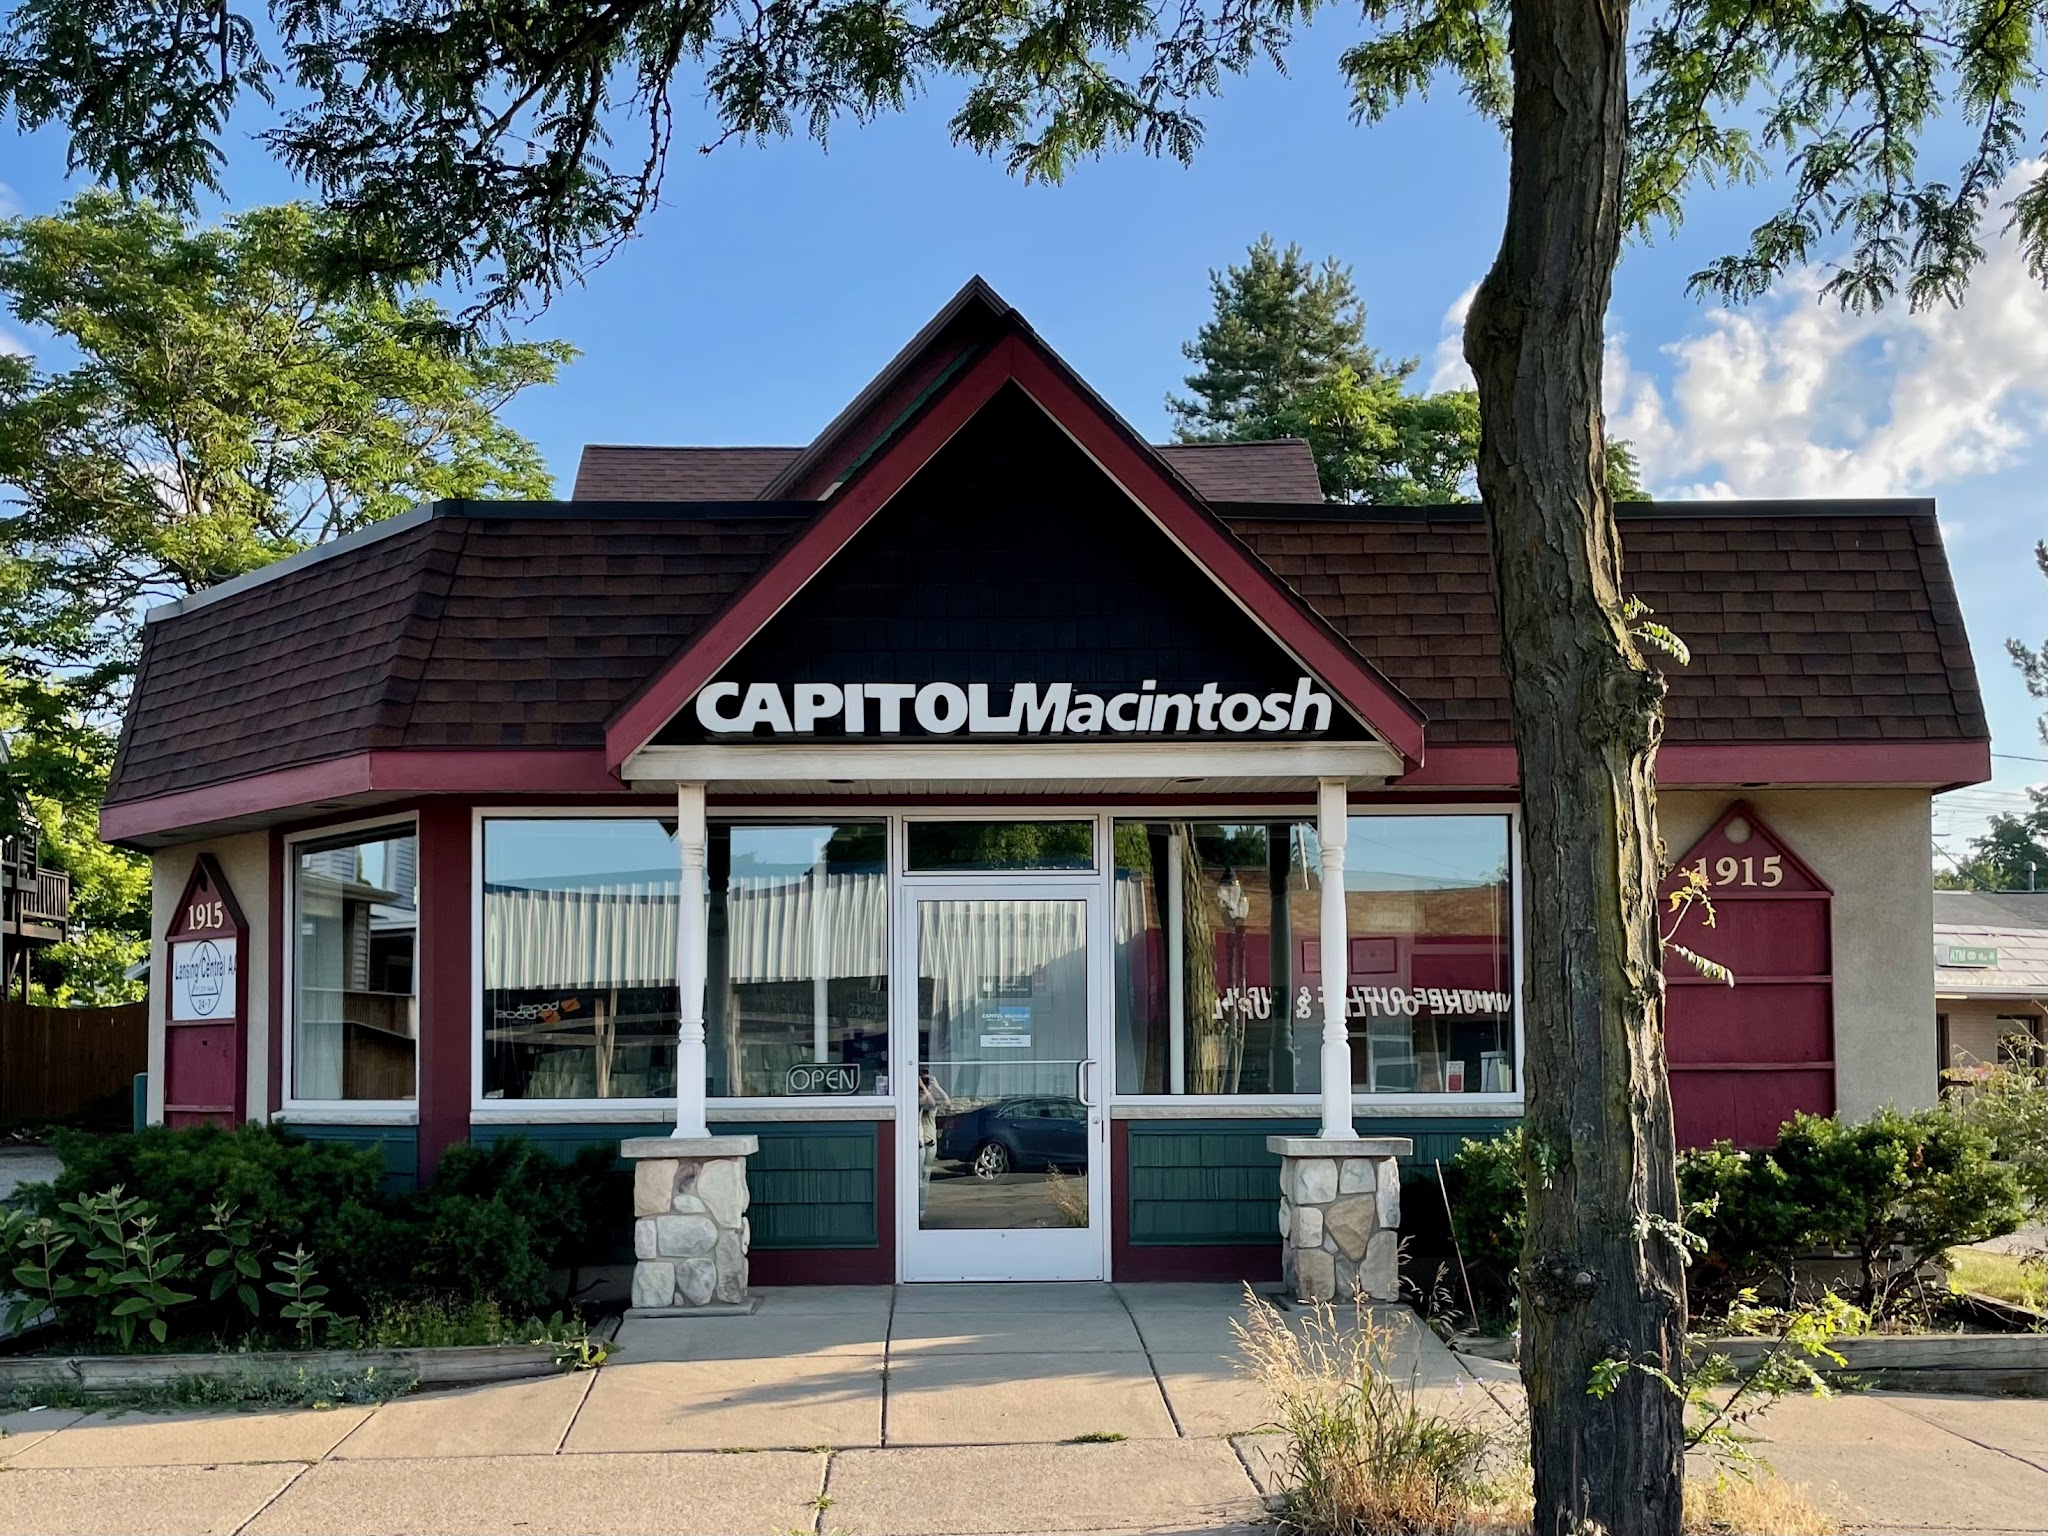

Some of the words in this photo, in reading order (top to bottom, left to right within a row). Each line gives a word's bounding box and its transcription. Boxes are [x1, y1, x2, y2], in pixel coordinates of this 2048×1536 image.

[1695, 854, 1783, 887] 1915
[188, 901, 224, 930] 1915
[175, 959, 198, 984] Lansing
[201, 954, 226, 978] Central
[1950, 949, 1966, 962] ATM
[790, 1069, 854, 1090] OPEN
